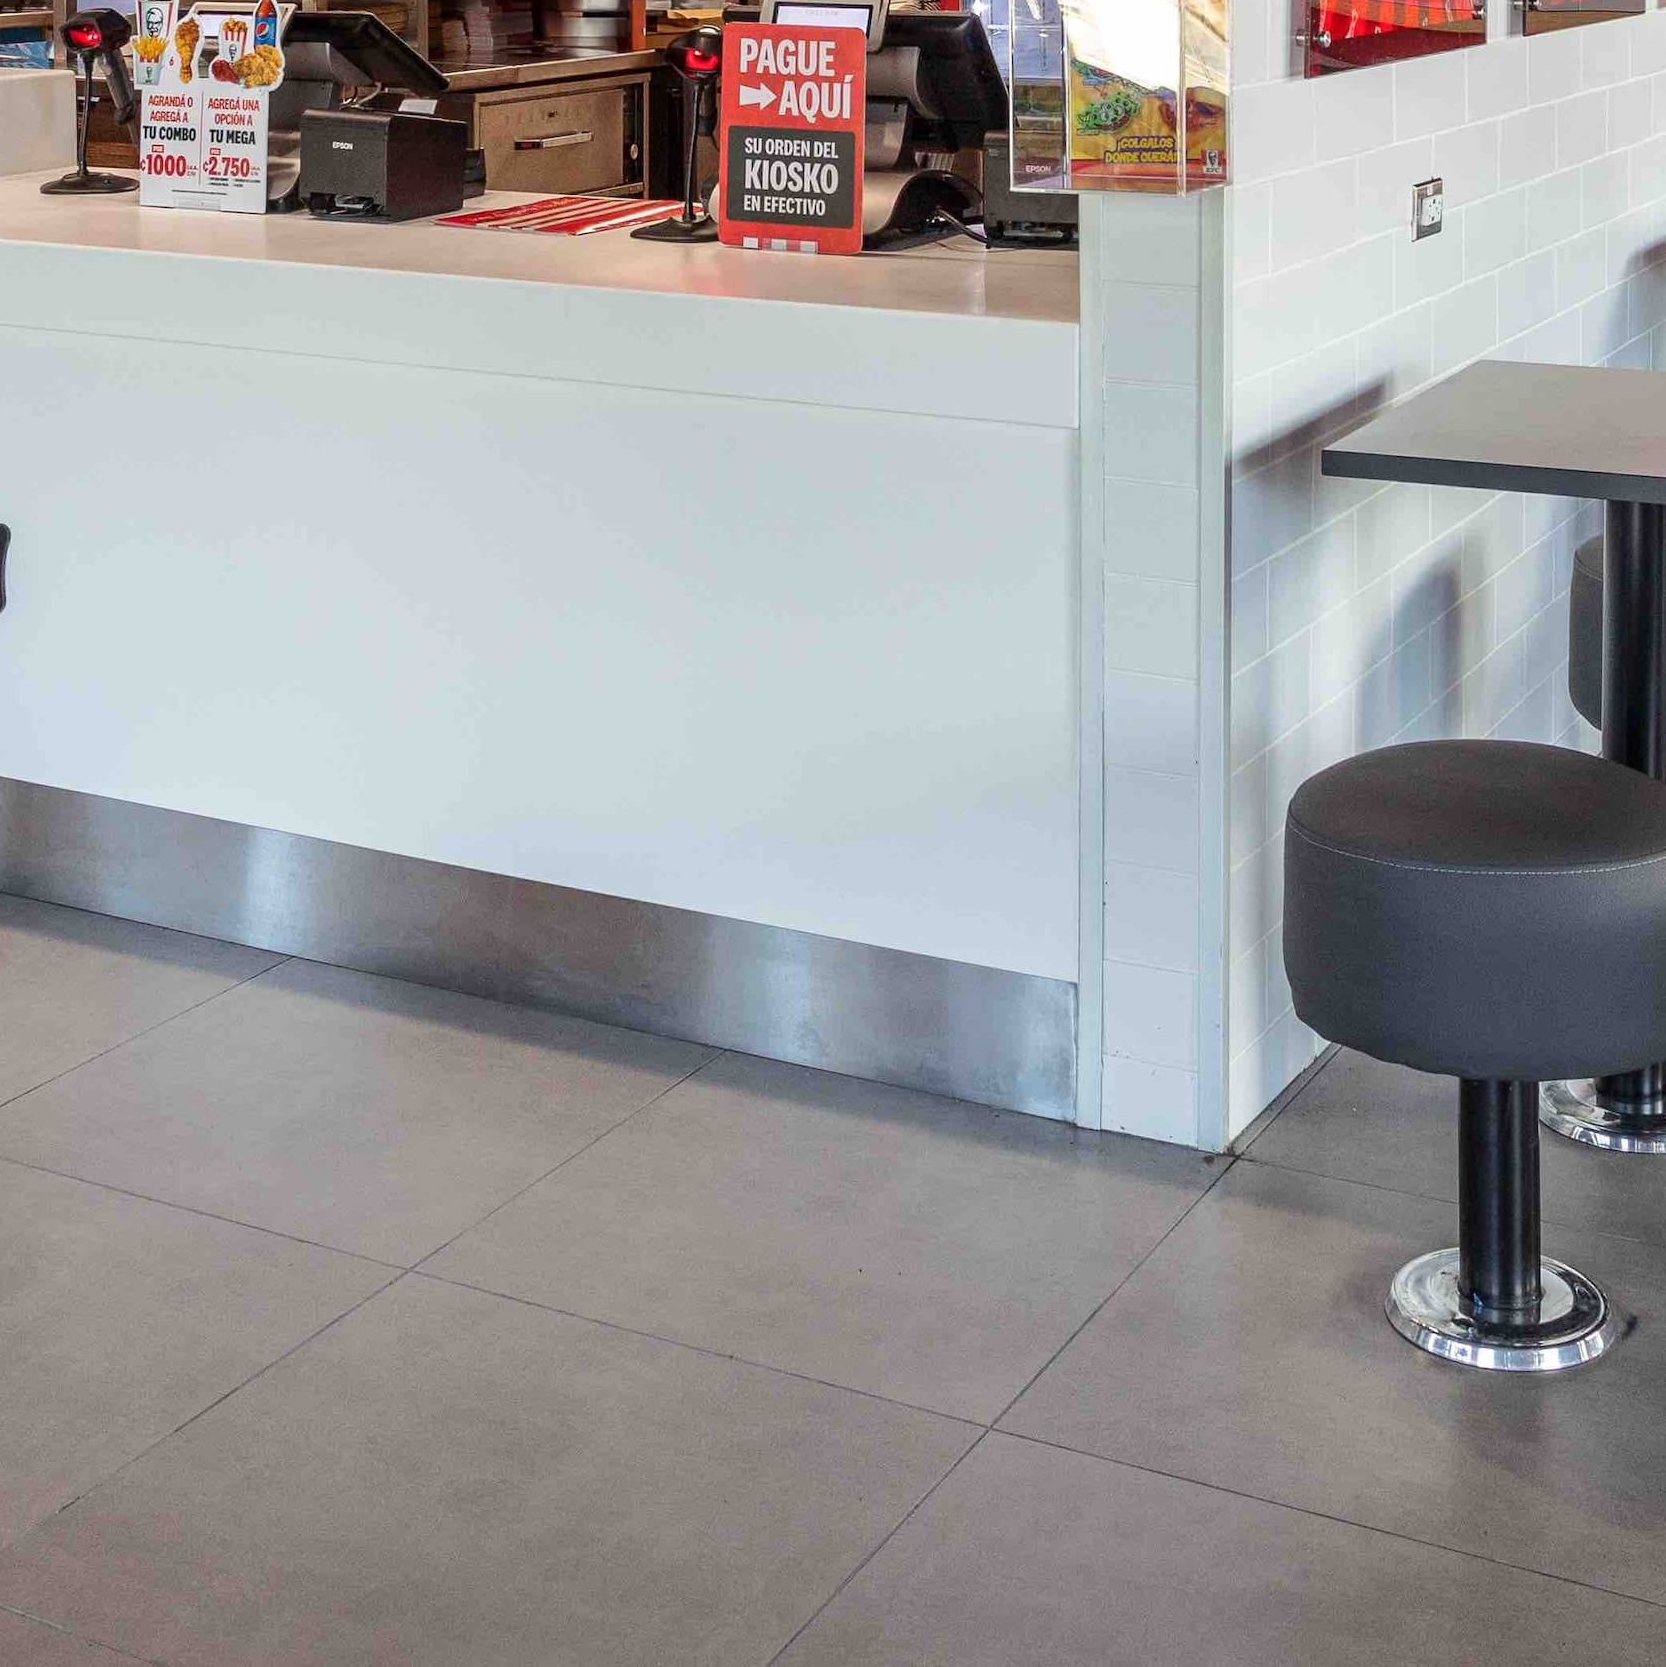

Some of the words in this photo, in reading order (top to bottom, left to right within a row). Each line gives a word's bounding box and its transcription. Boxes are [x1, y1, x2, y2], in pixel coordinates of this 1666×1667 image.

[739, 37, 836, 77] PAGUE
[148, 94, 186, 107] AGRANDÁ
[243, 100, 260, 111] UNA
[778, 74, 855, 124] AQUÍ
[215, 112, 245, 126] OPCIÓN
[247, 115, 253, 126] A
[143, 126, 157, 140] TU
[159, 126, 197, 141] COMBO
[209, 129, 224, 143] TU
[226, 130, 256, 145] MEGA
[333, 141, 353, 150] EPSON
[744, 136, 762, 155] SU
[765, 138, 811, 158] ORDEN
[813, 141, 839, 159] DEL
[1105, 151, 1138, 163] DONDE
[1025, 164, 1051, 173] EPSON
[744, 158, 840, 195] KIOSKO
[743, 194, 761, 213] EN
[763, 196, 826, 216] EFECTIVO
